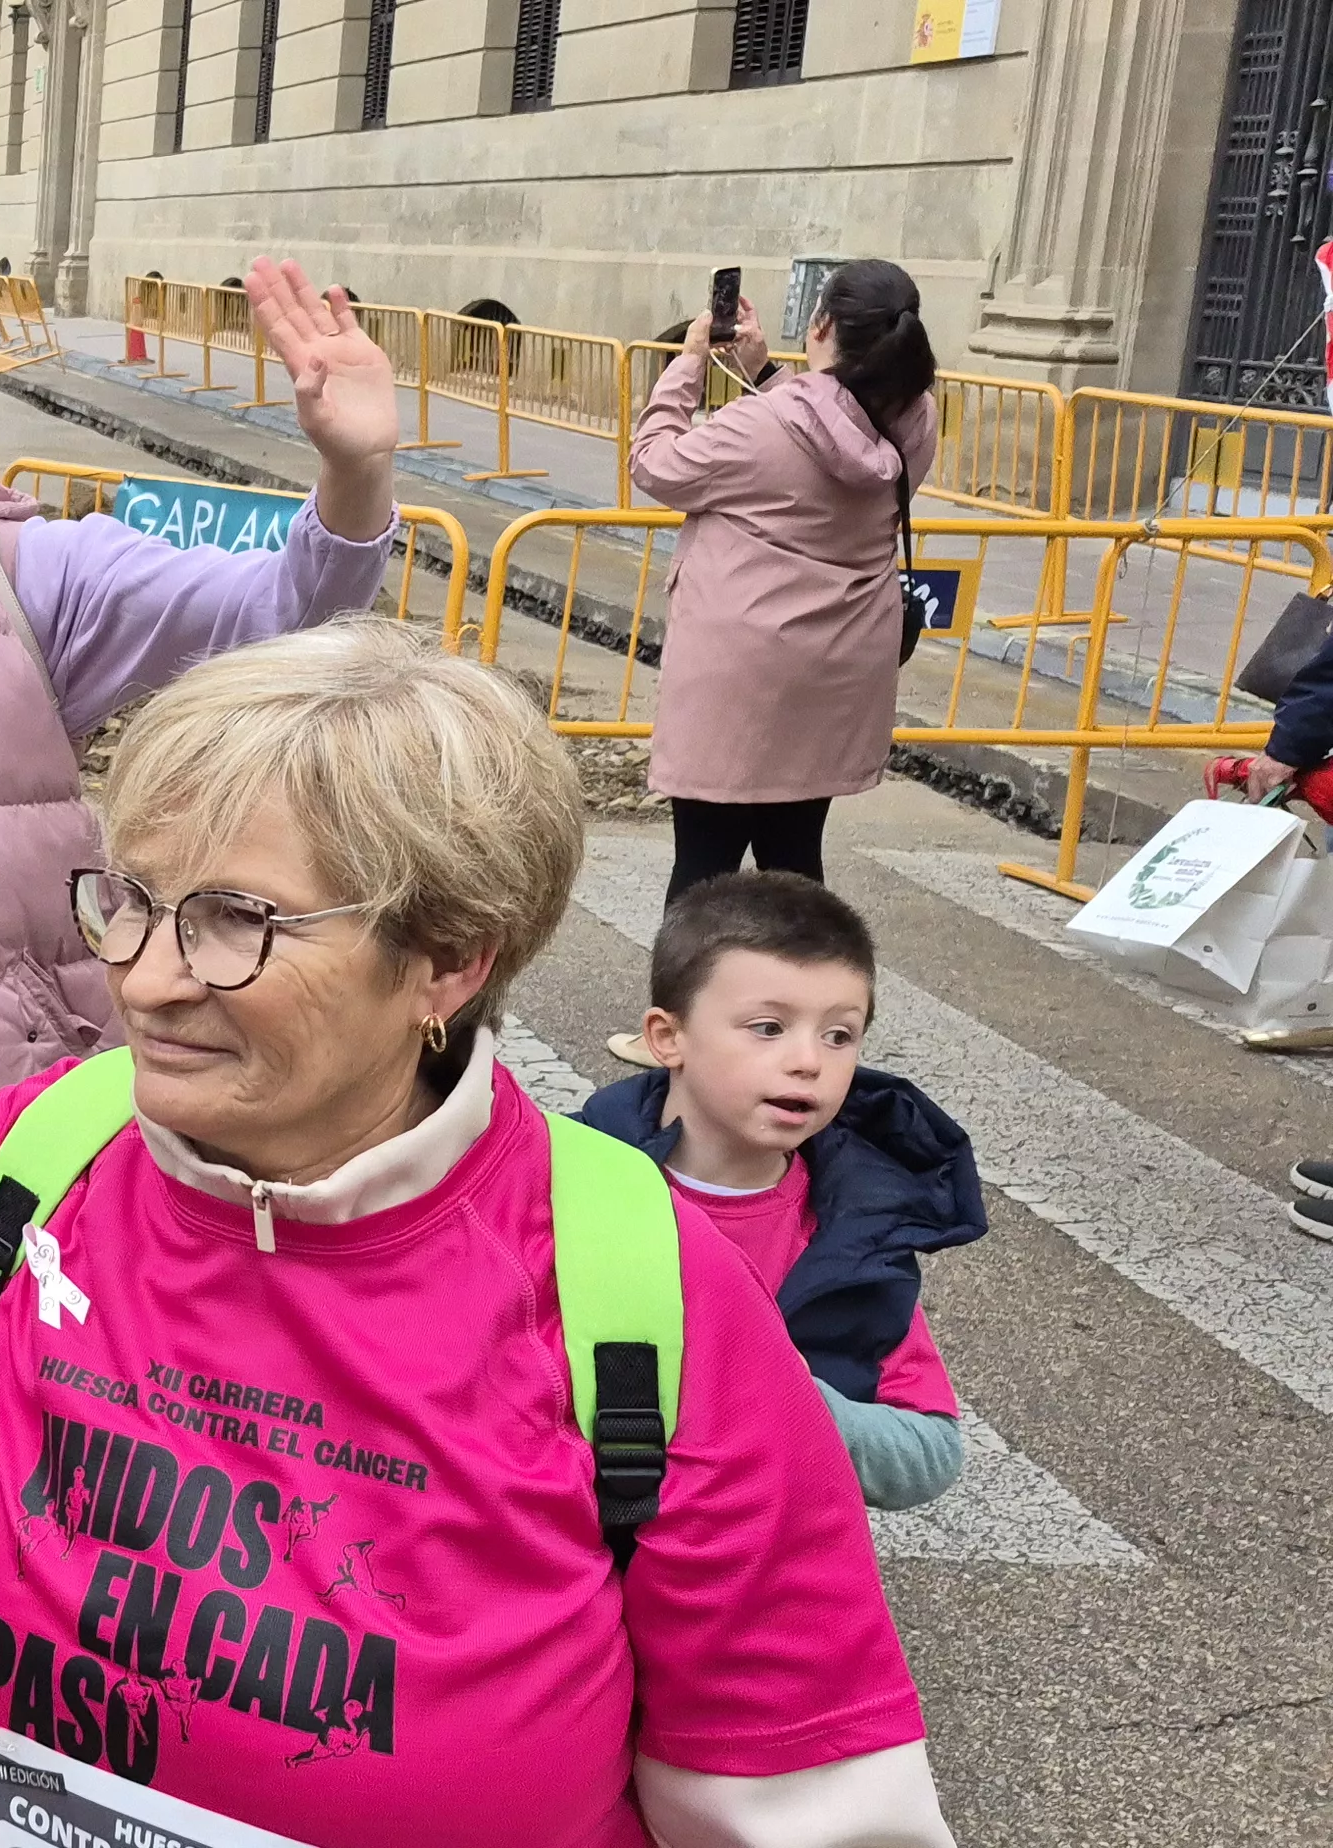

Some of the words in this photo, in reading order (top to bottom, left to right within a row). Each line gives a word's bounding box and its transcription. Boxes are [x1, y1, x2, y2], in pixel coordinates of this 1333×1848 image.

[39, 1355, 139, 1408] HUESCA
[147, 1392, 260, 1447] CONTRA
[268, 1428, 304, 1459] EL
[313, 1440, 429, 1491] CÁNCER
[145, 1359, 183, 1392] XII
[188, 1369, 325, 1429] CARRERA
[20, 1411, 282, 1589] UNIDOS
[78, 1550, 183, 1675] EN
[186, 1589, 397, 1756] CADA
[9, 1768, 60, 1791] EDICIÓN
